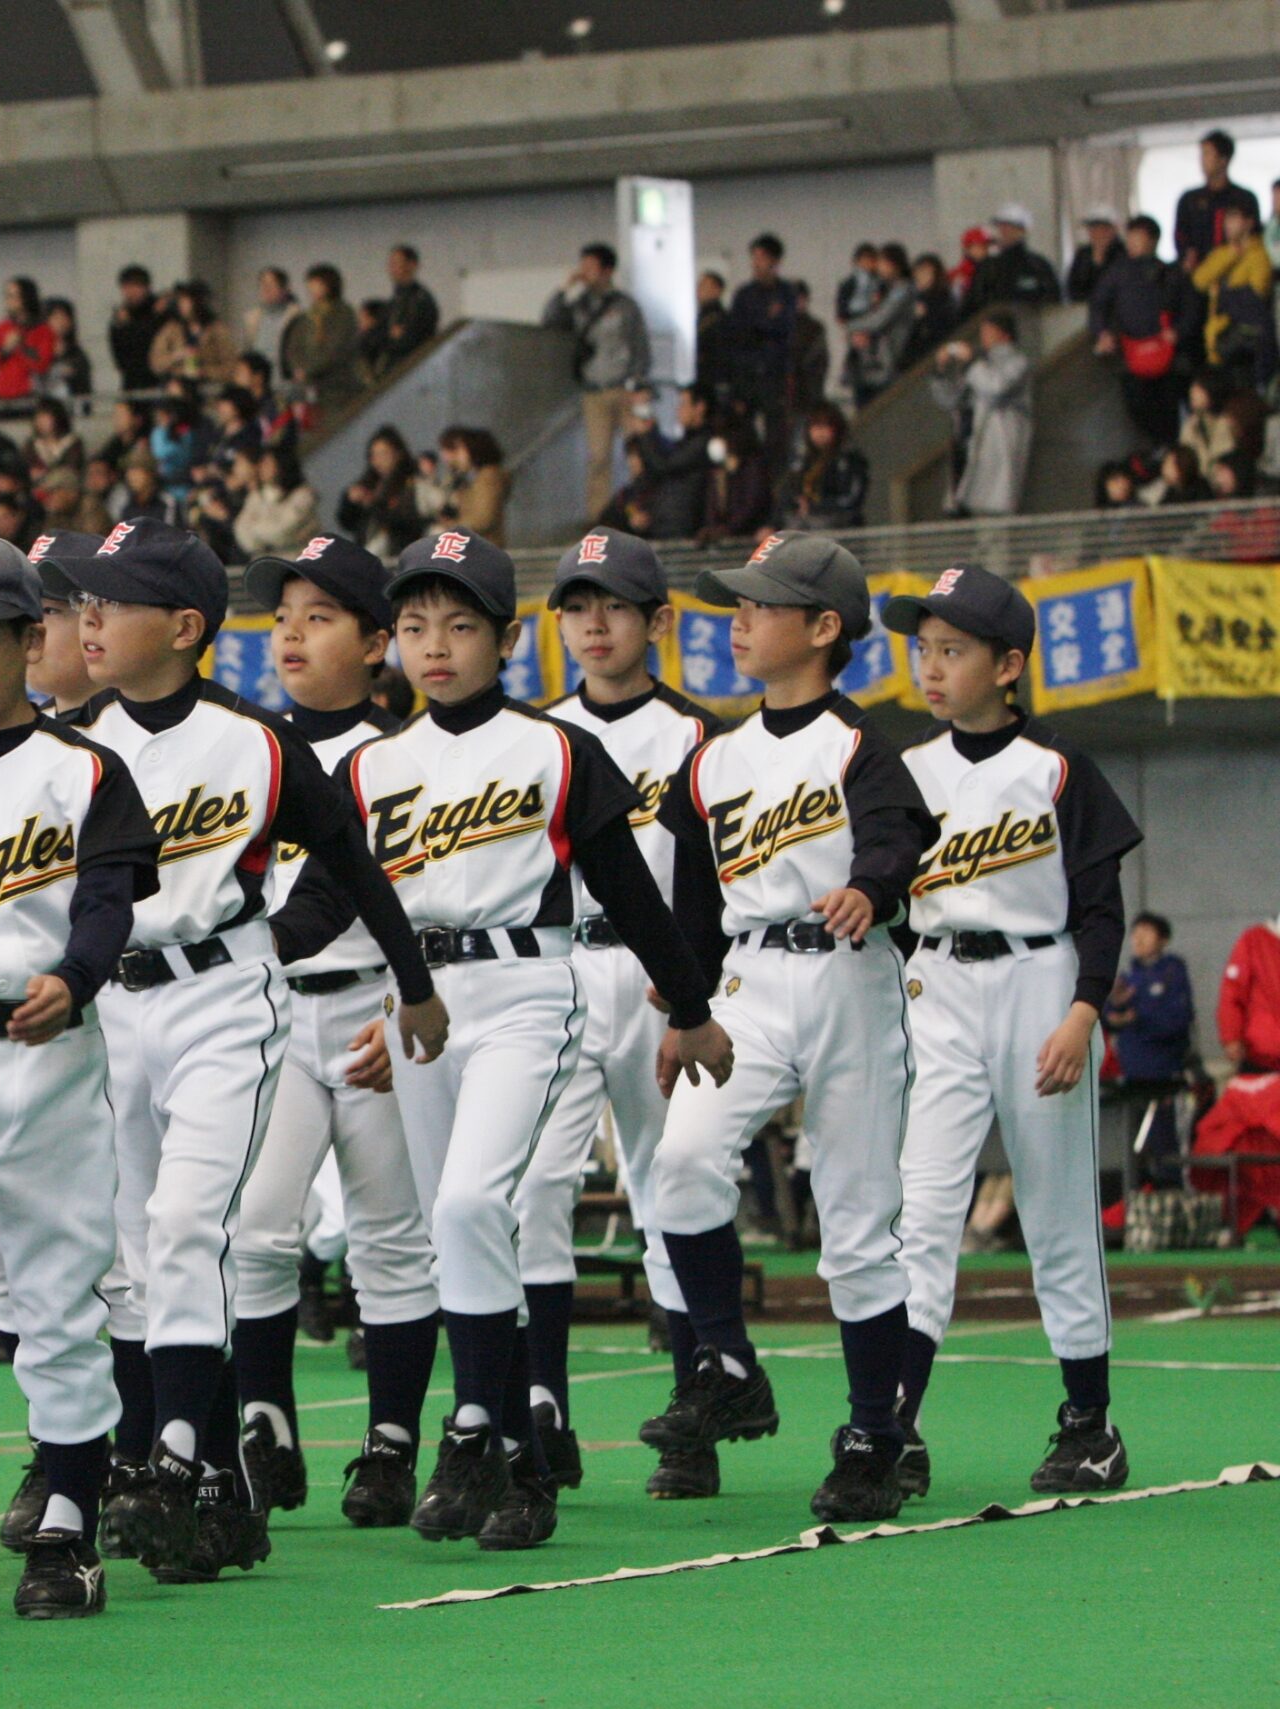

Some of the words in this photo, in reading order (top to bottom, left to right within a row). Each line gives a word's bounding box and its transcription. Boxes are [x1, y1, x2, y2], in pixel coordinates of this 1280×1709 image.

[431, 532, 470, 563] E
[578, 534, 608, 565] E
[369, 778, 545, 864] Eagles
[708, 778, 843, 867] Eagles
